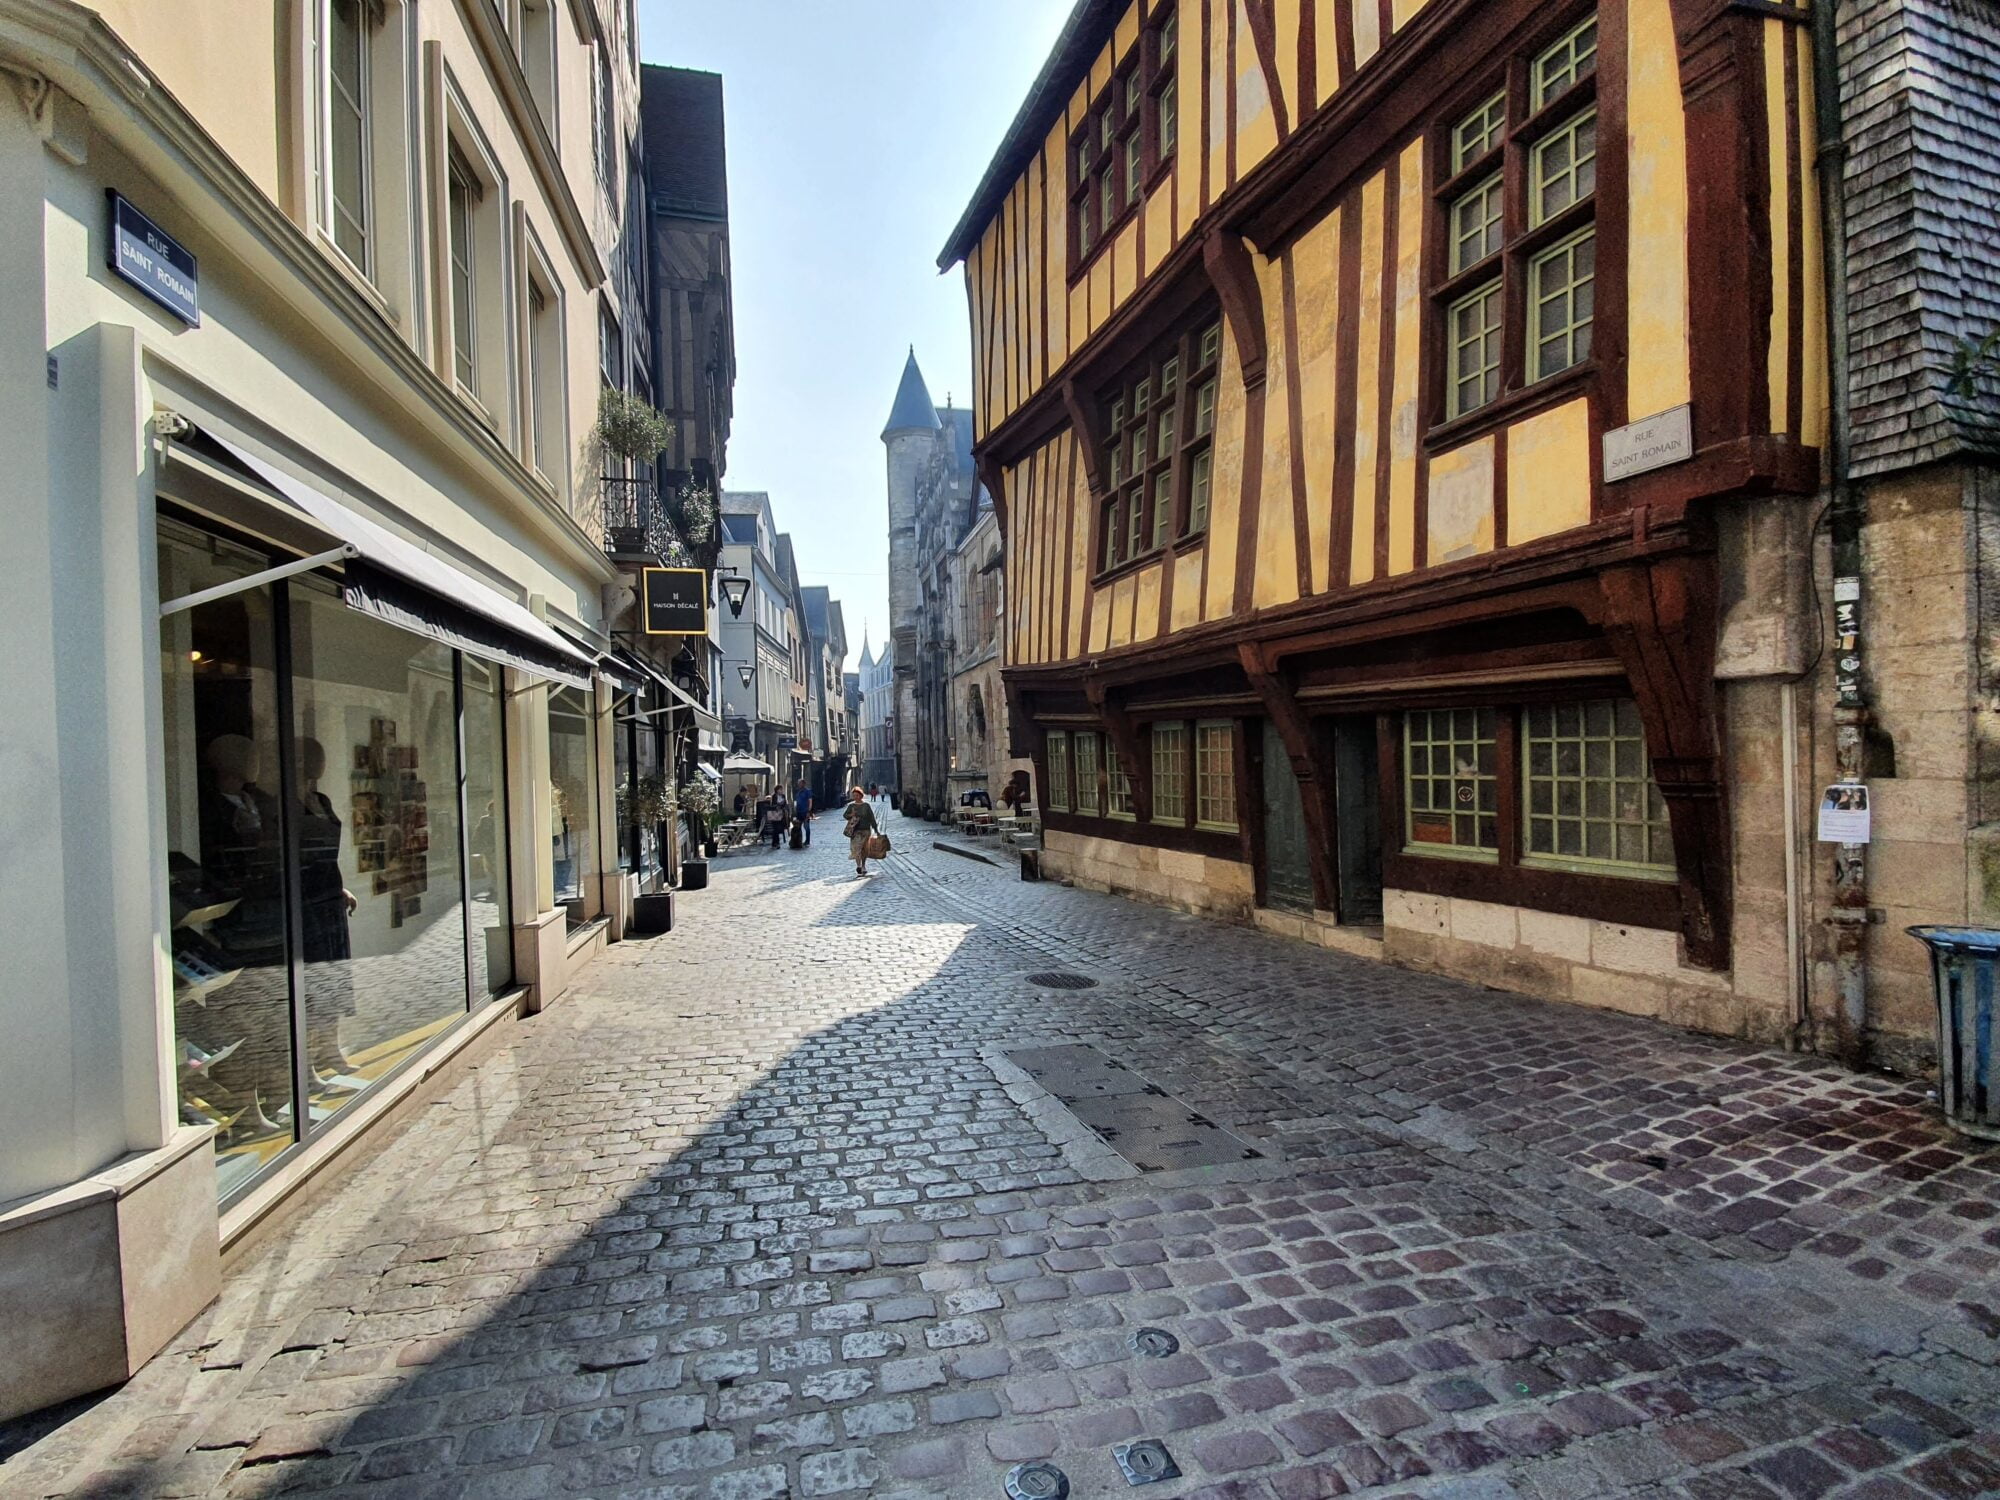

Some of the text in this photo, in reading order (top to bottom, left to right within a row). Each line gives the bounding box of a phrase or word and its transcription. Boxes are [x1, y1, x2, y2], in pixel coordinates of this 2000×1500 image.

[147, 232, 170, 260] RUE
[122, 241, 194, 305] SAINT ROMAIN
[1634, 429, 1654, 443] RUE
[1612, 440, 1682, 468] SAINT ROMAIN
